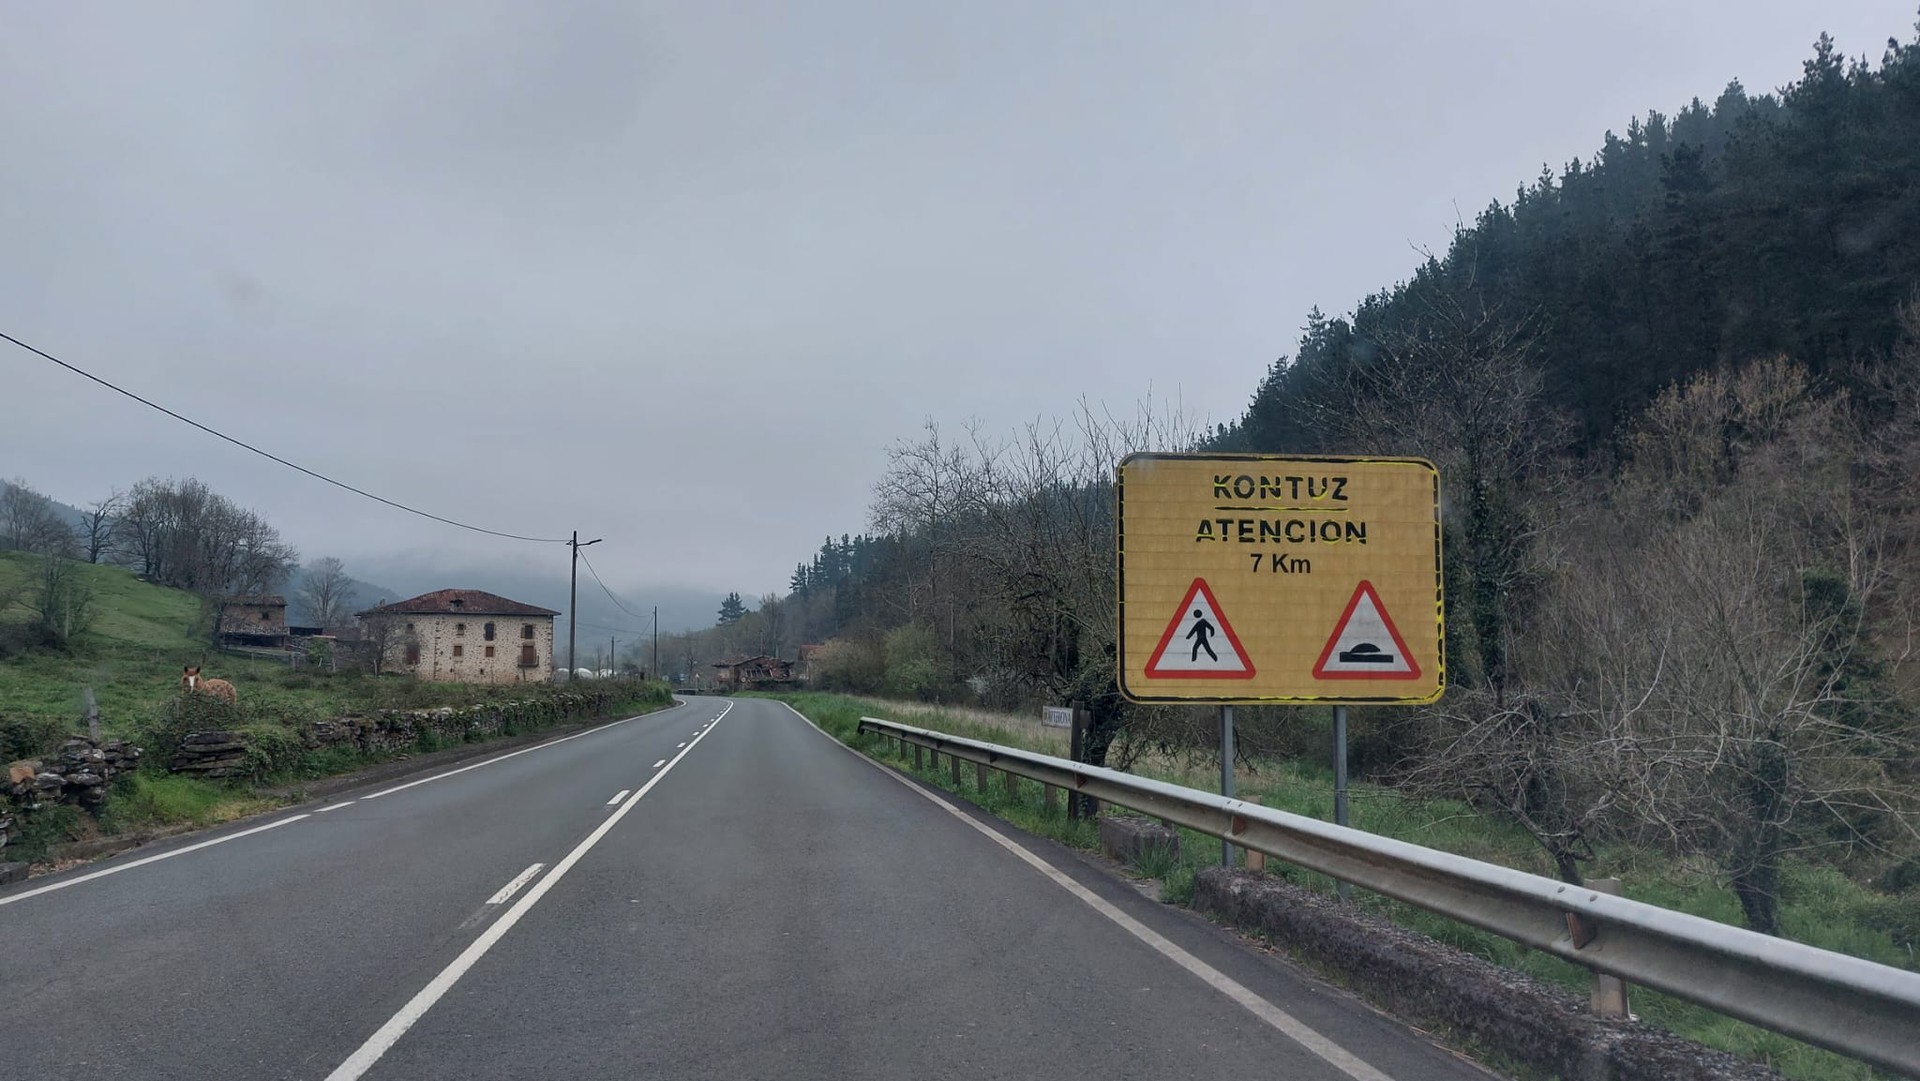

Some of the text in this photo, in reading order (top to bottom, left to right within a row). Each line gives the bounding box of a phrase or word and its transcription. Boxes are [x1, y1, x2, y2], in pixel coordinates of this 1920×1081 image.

[1214, 475, 1349, 501] KONTUZ
[1196, 520, 1367, 545] ATENCION
[1250, 554, 1311, 574] 7 Km
